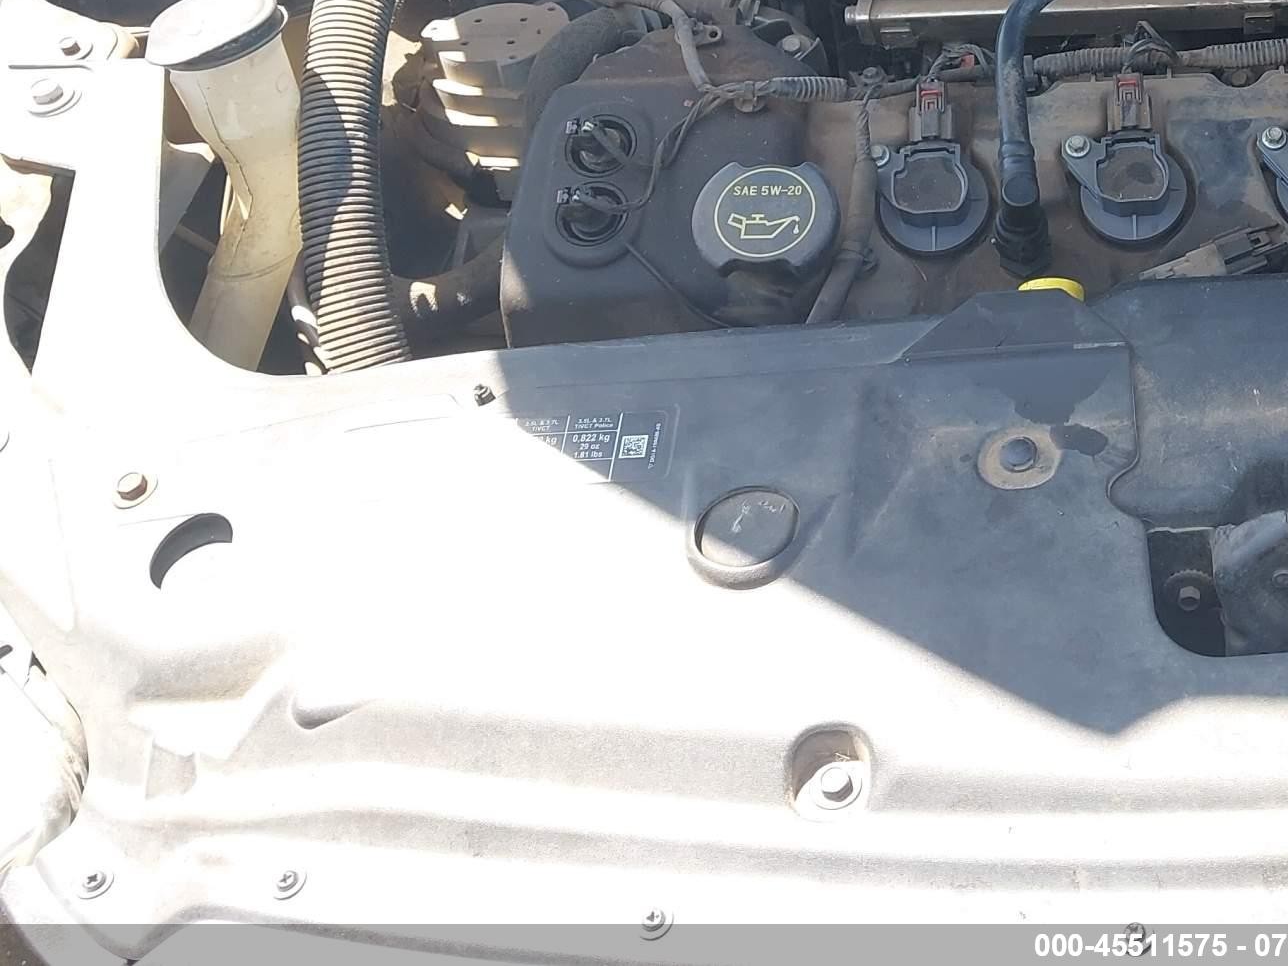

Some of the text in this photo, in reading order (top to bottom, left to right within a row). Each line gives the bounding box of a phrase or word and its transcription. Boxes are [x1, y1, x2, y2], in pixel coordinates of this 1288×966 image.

[733, 185, 803, 196] SAE 5W-20
[599, 434, 611, 443] kg
[590, 450, 603, 458] lbs
